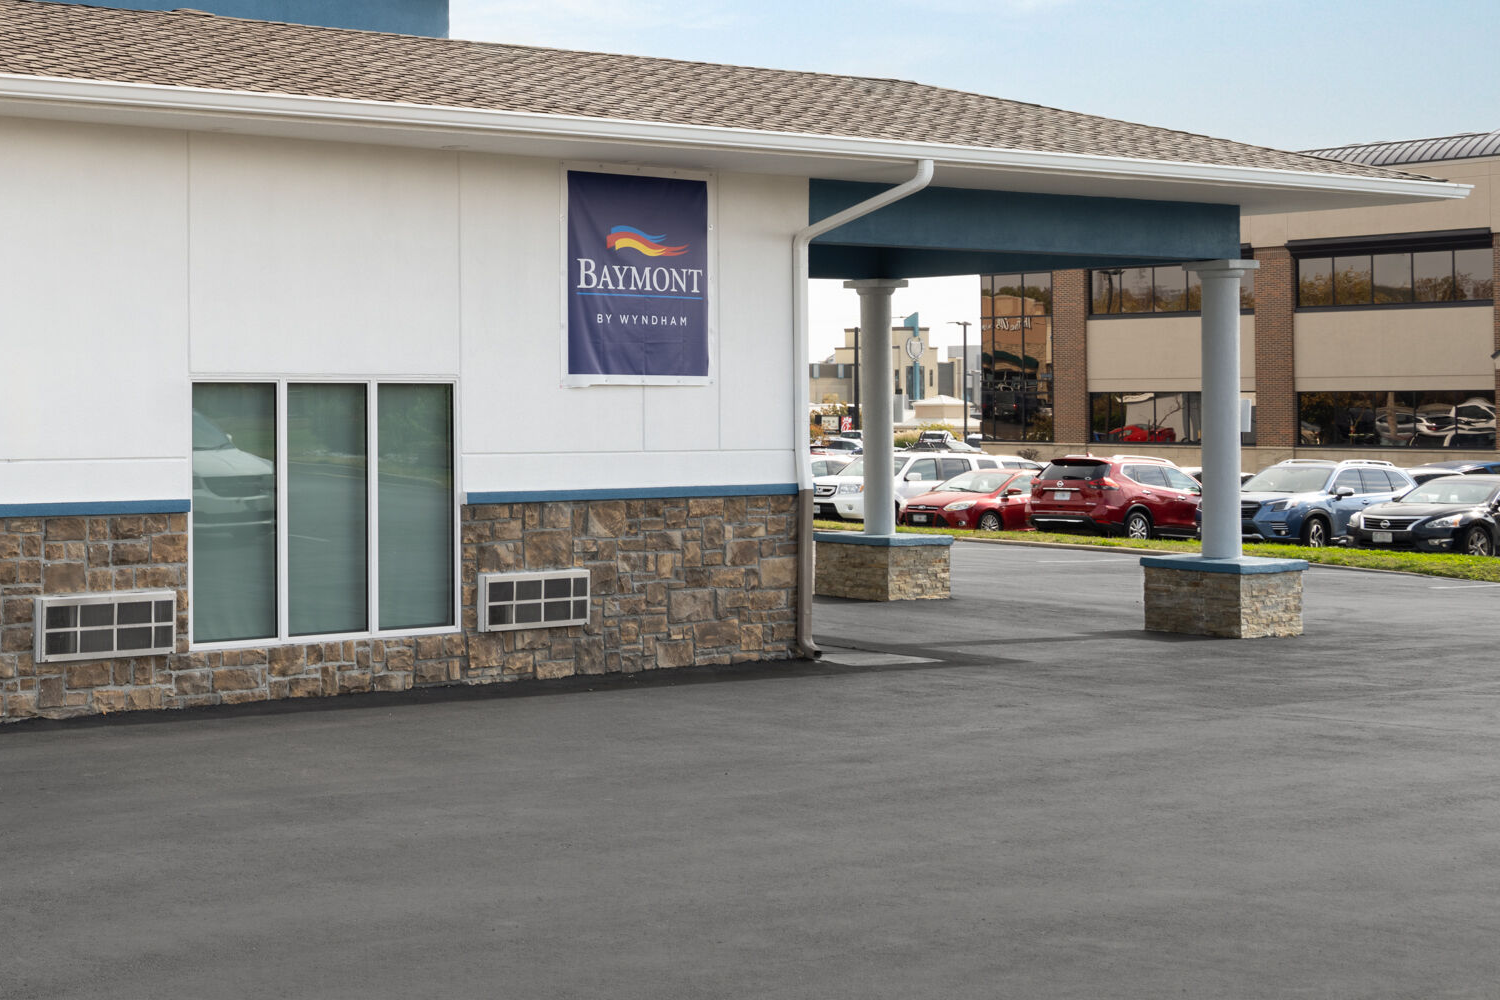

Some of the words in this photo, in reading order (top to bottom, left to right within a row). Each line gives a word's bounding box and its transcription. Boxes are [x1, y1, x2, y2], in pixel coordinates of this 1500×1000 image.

[577, 258, 703, 293] BAYMONT
[596, 313, 613, 324] BY
[619, 314, 687, 327] WYNDHAM
